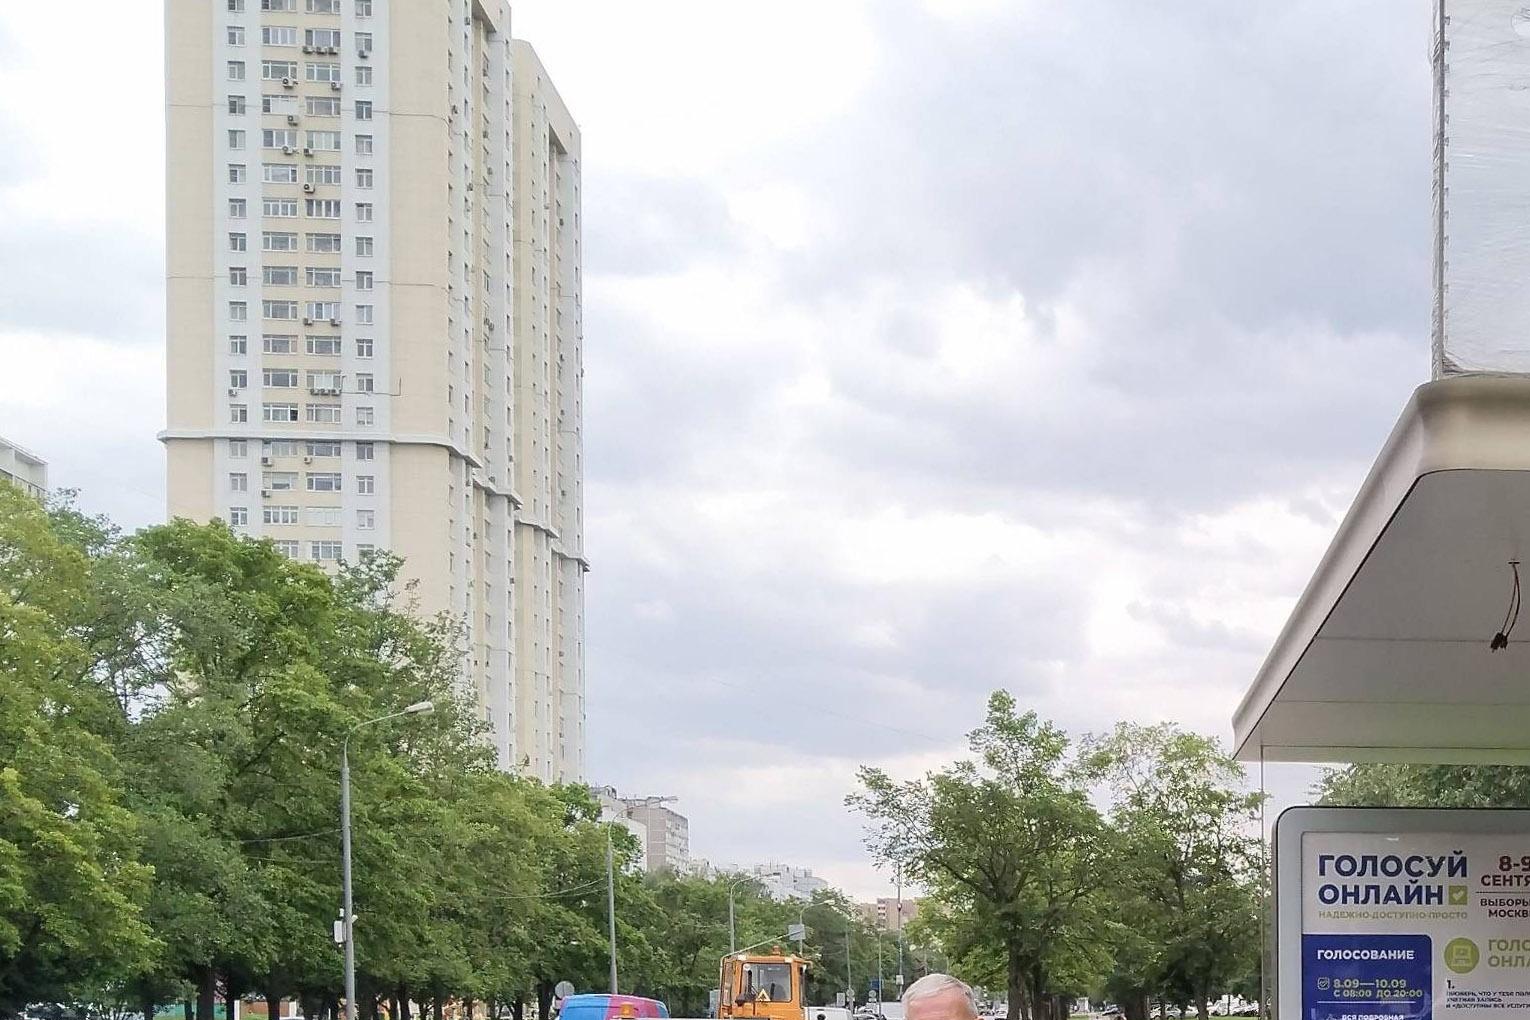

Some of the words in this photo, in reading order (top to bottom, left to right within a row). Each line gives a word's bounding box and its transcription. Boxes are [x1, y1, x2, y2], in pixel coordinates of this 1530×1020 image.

[1319, 850, 1467, 877] ГОЛОСУЙ
[1318, 879, 1443, 905] ОНЛАЙН
[1317, 950, 1415, 960] ГОЛОСОВАНИЕ
[1446, 980, 1455, 989] 1.
[1333, 990, 1341, 998] С
[1343, 990, 1372, 998] 08:00
[1376, 990, 1391, 999] ДО
[1393, 990, 1423, 998] 20:00
